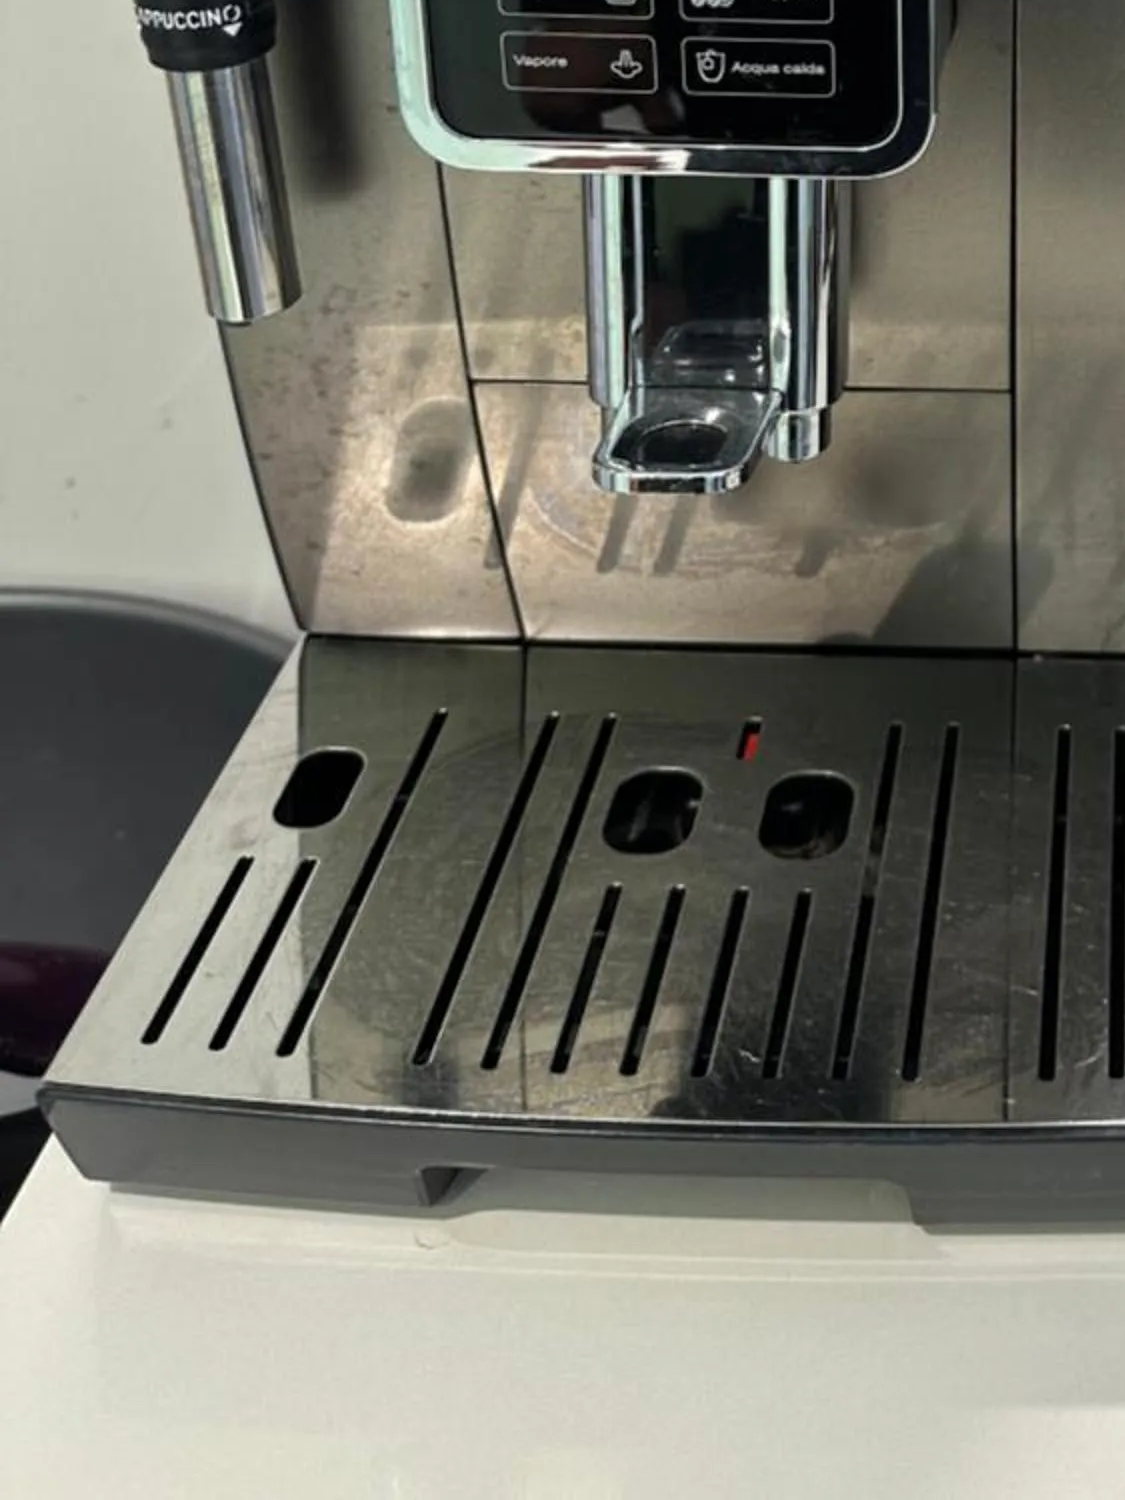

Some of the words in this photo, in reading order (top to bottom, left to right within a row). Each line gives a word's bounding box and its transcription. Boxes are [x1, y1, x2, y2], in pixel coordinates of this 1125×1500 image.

[512, 53, 569, 69] Vapore
[731, 61, 779, 76] Acqua
[783, 62, 826, 76] calda
